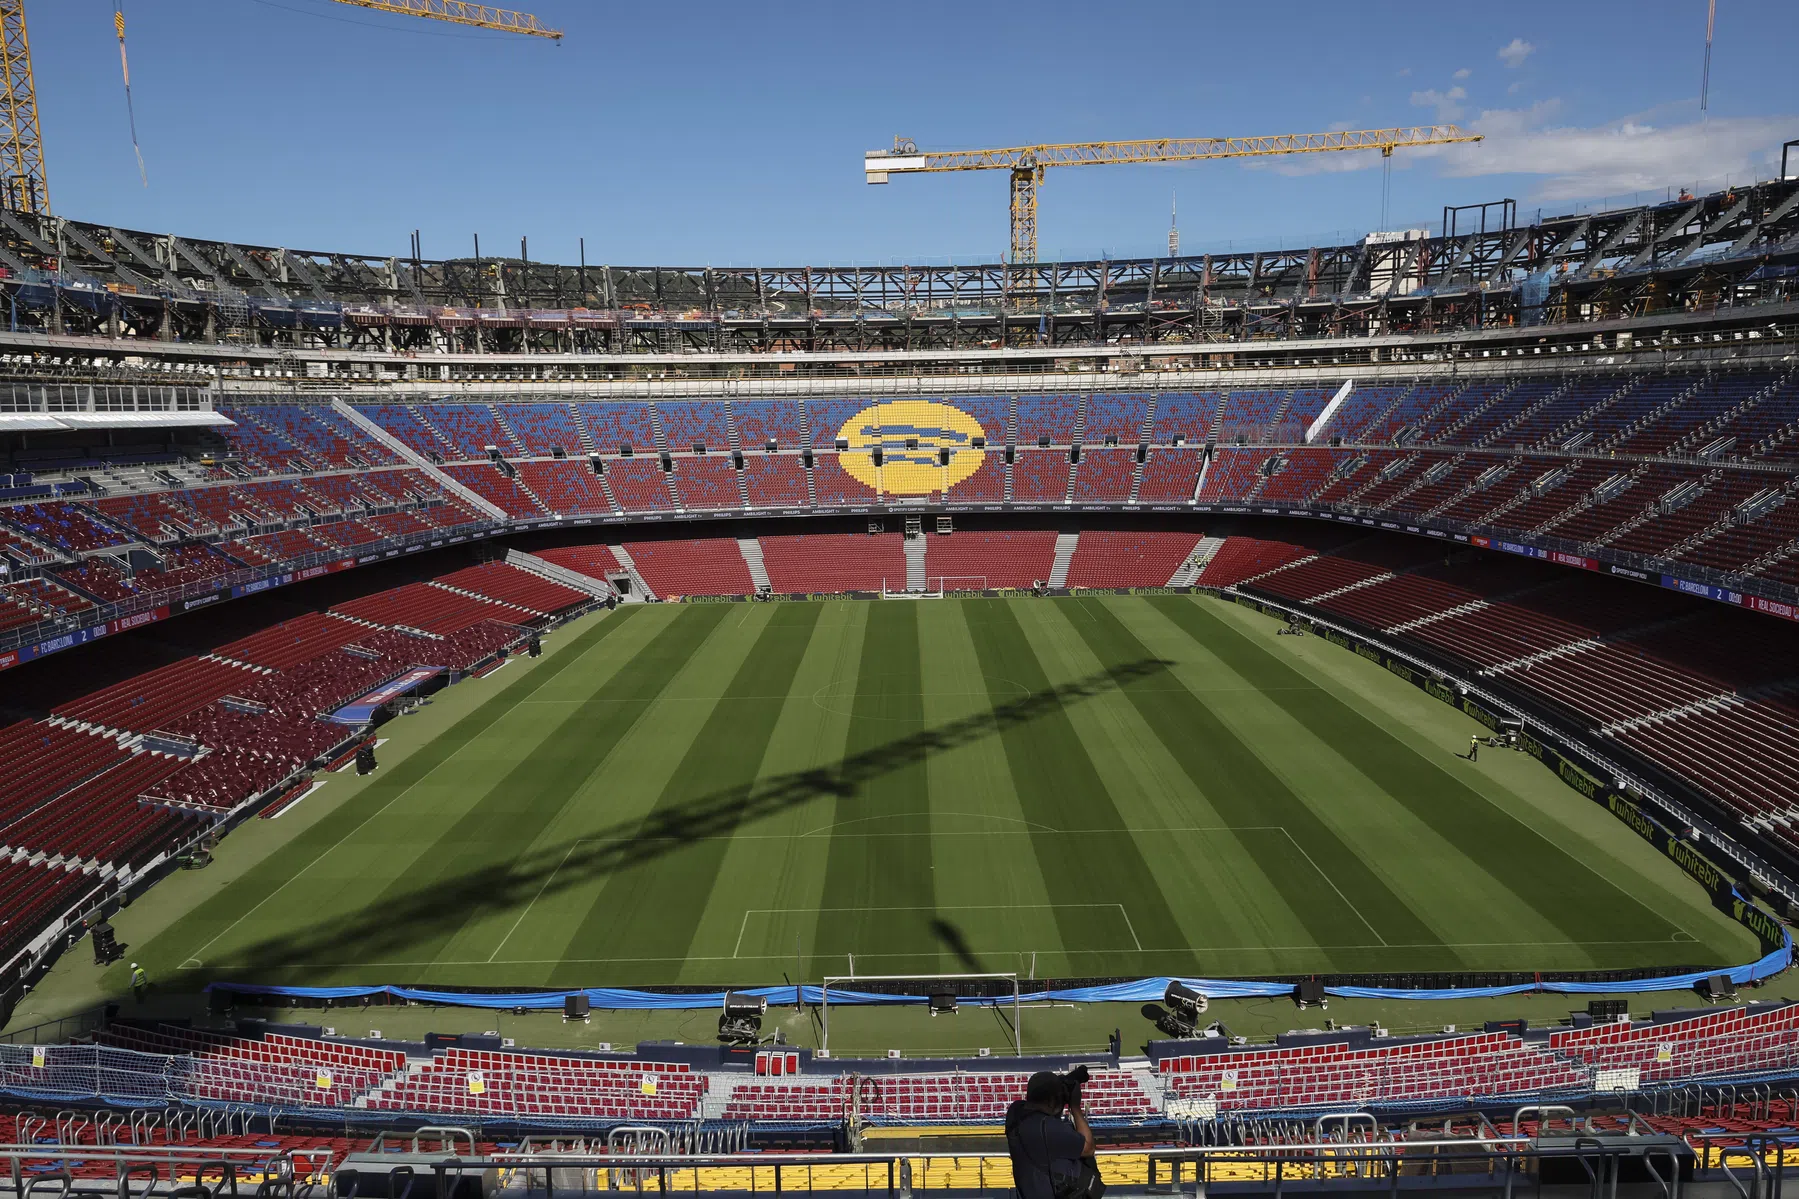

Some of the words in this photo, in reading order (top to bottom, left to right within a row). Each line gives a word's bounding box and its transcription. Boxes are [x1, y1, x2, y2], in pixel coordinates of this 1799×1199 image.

[1552, 552, 1556, 560] 1
[275, 577, 279, 585] 2
[297, 572, 301, 580] 1
[694, 595, 732, 603] whitebit
[812, 593, 853, 601] whitebit
[1077, 588, 1116, 596] whitebit
[1135, 586, 1175, 595] whitebit
[1680, 580, 1685, 591] FC
[1685, 581, 1708, 595] BARCELONA
[1717, 589, 1721, 599] 2
[1729, 591, 1741, 603] 00:00
[1750, 598, 1754, 608] 1
[1758, 600, 1769, 611] REAL
[1769, 601, 1792, 617] SOCIEDAD
[41, 642, 47, 653] FC
[82, 631, 87, 641] 2
[93, 625, 106, 638] 00:00
[114, 621, 118, 632] 1
[1468, 702, 1496, 729] whitebit
[1563, 765, 1595, 799] whitebit
[1617, 801, 1654, 840] whitebit
[1675, 846, 1720, 892] whitebit
